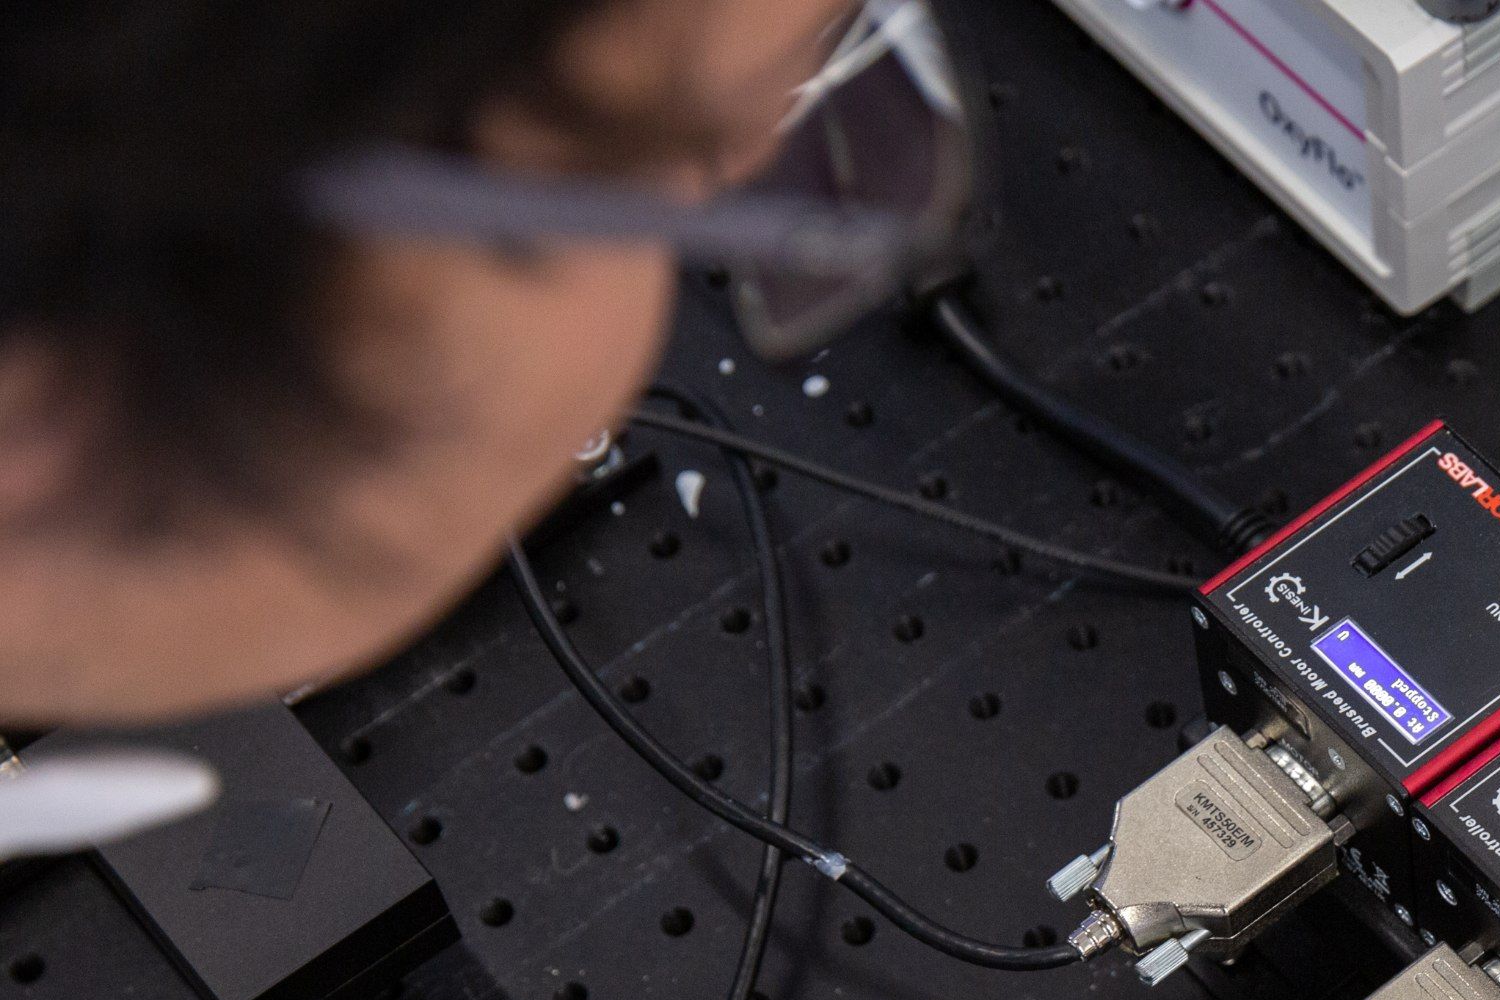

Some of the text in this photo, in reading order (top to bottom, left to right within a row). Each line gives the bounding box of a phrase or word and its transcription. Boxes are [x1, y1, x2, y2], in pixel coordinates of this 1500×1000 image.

[1234, 603, 1292, 658] Controller
[1290, 657, 1328, 691] Motor
[1348, 662, 1425, 733] At 0.0000 mm
[1323, 690, 1377, 738] Brushed
[1391, 678, 1439, 723] Stopped
[1193, 792, 1255, 848] KMTS50E/M
[1202, 816, 1237, 849] 457329
